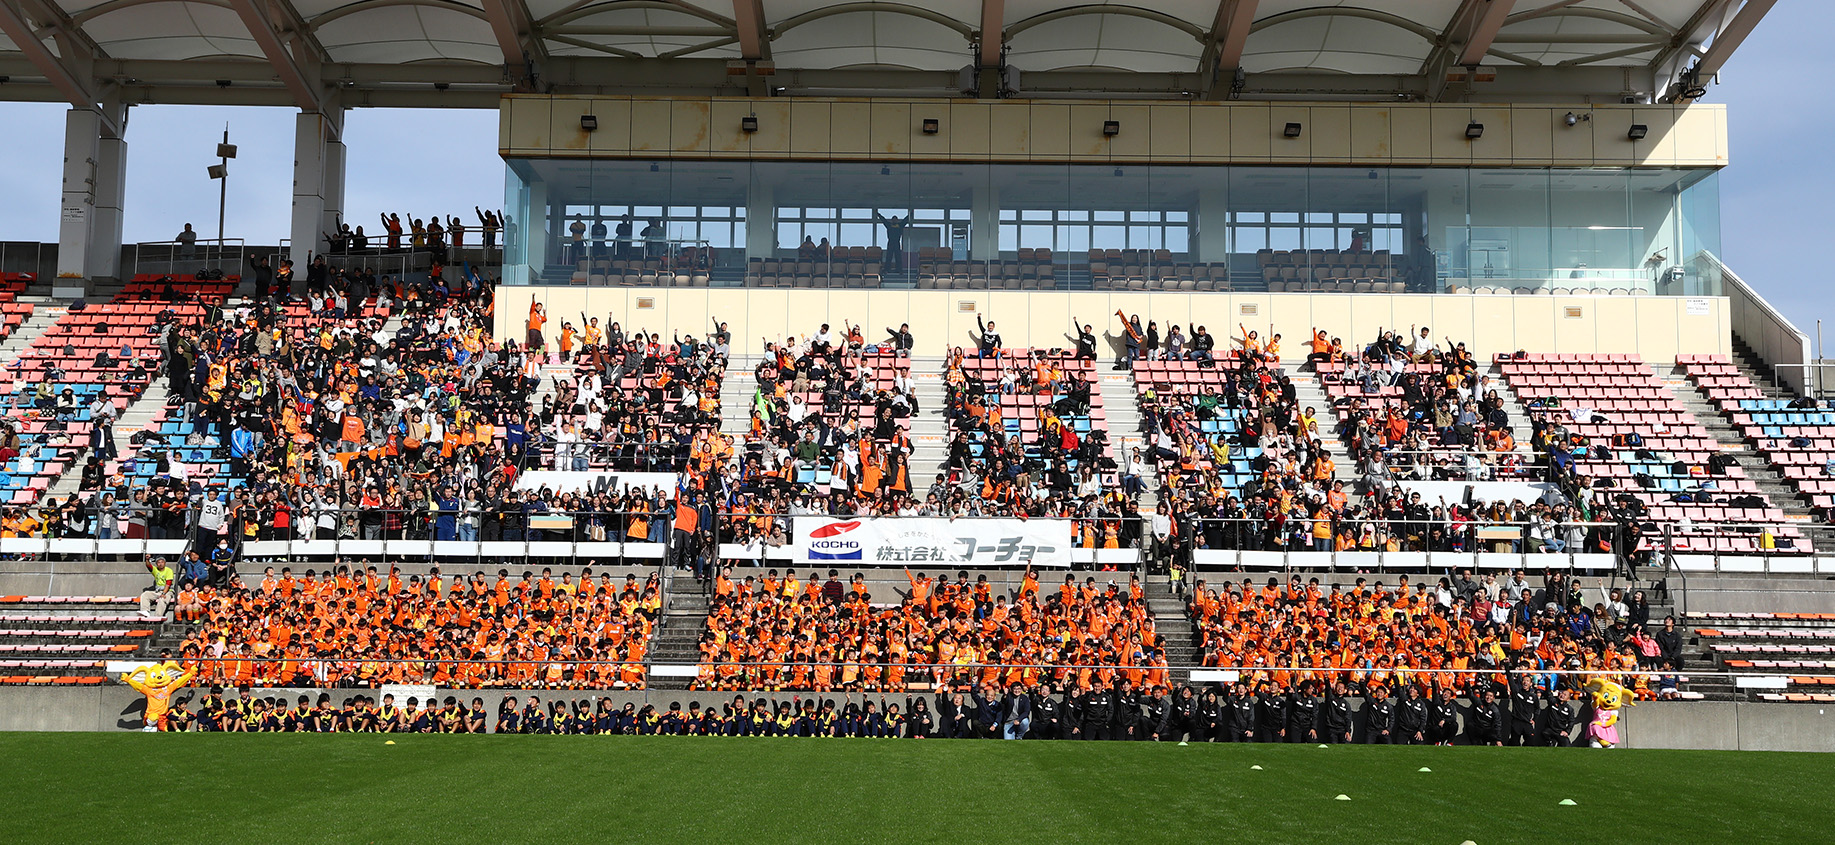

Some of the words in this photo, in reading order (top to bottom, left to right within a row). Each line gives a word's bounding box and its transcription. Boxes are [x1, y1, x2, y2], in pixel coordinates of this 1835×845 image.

[205, 505, 218, 515] 33
[876, 545, 946, 561] 株式会社
[950, 536, 1055, 561] コーチョー
